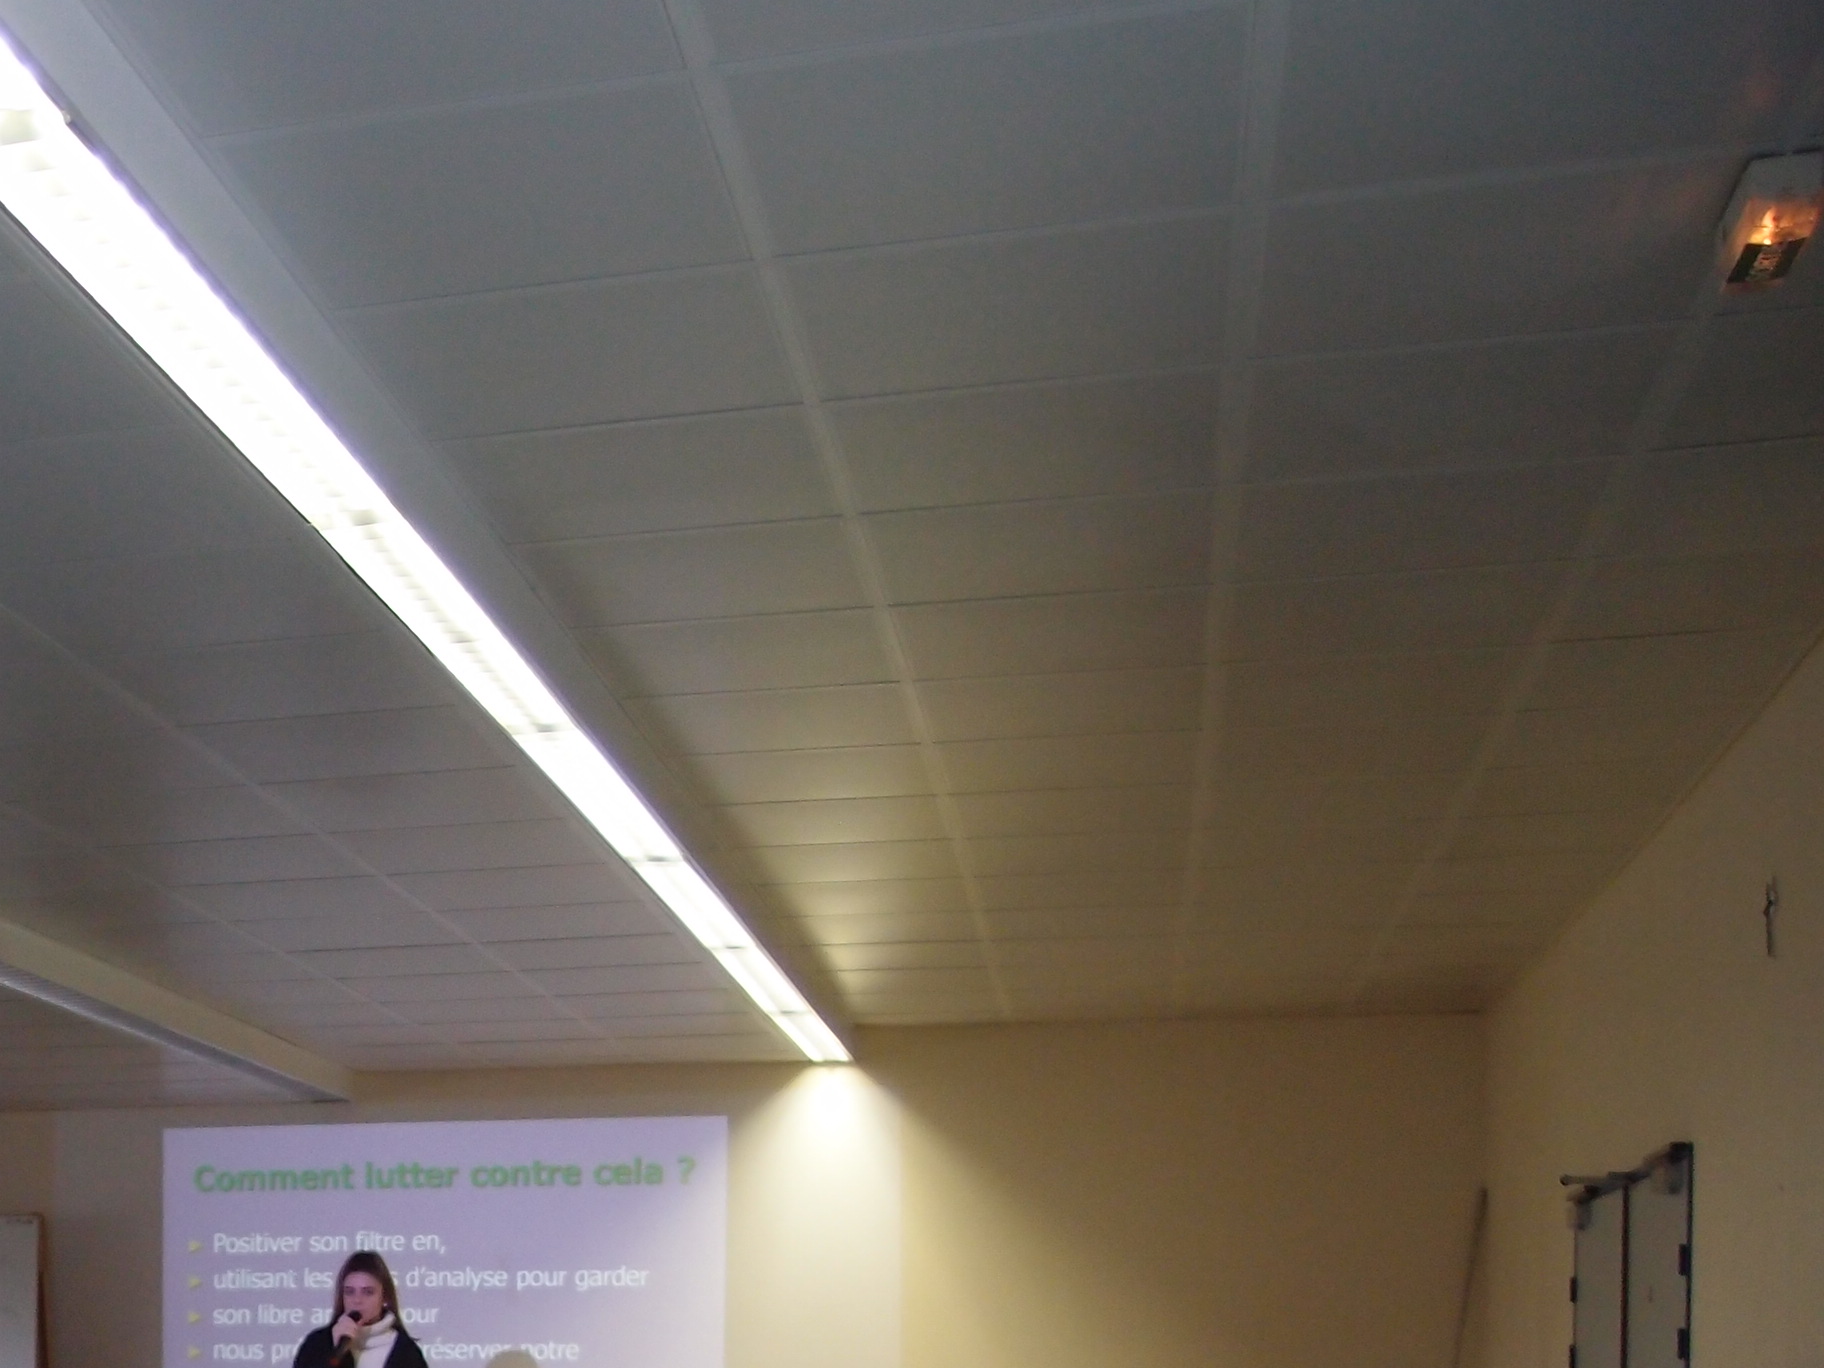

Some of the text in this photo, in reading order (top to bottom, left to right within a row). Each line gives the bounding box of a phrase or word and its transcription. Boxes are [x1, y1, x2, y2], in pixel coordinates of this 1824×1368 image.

[194, 1155, 696, 1192] Comment lutter contre cela ?
[213, 1230, 446, 1255] Positiver son filtre en,
[213, 1269, 297, 1289] utilisant
[303, 1267, 333, 1288] les
[405, 1266, 508, 1291] d'analyse
[516, 1268, 568, 1291] pour
[574, 1265, 650, 1292] garder
[212, 1307, 251, 1325] son
[257, 1303, 304, 1325] libre
[401, 1306, 440, 1324] our
[212, 1343, 264, 1361] nous
